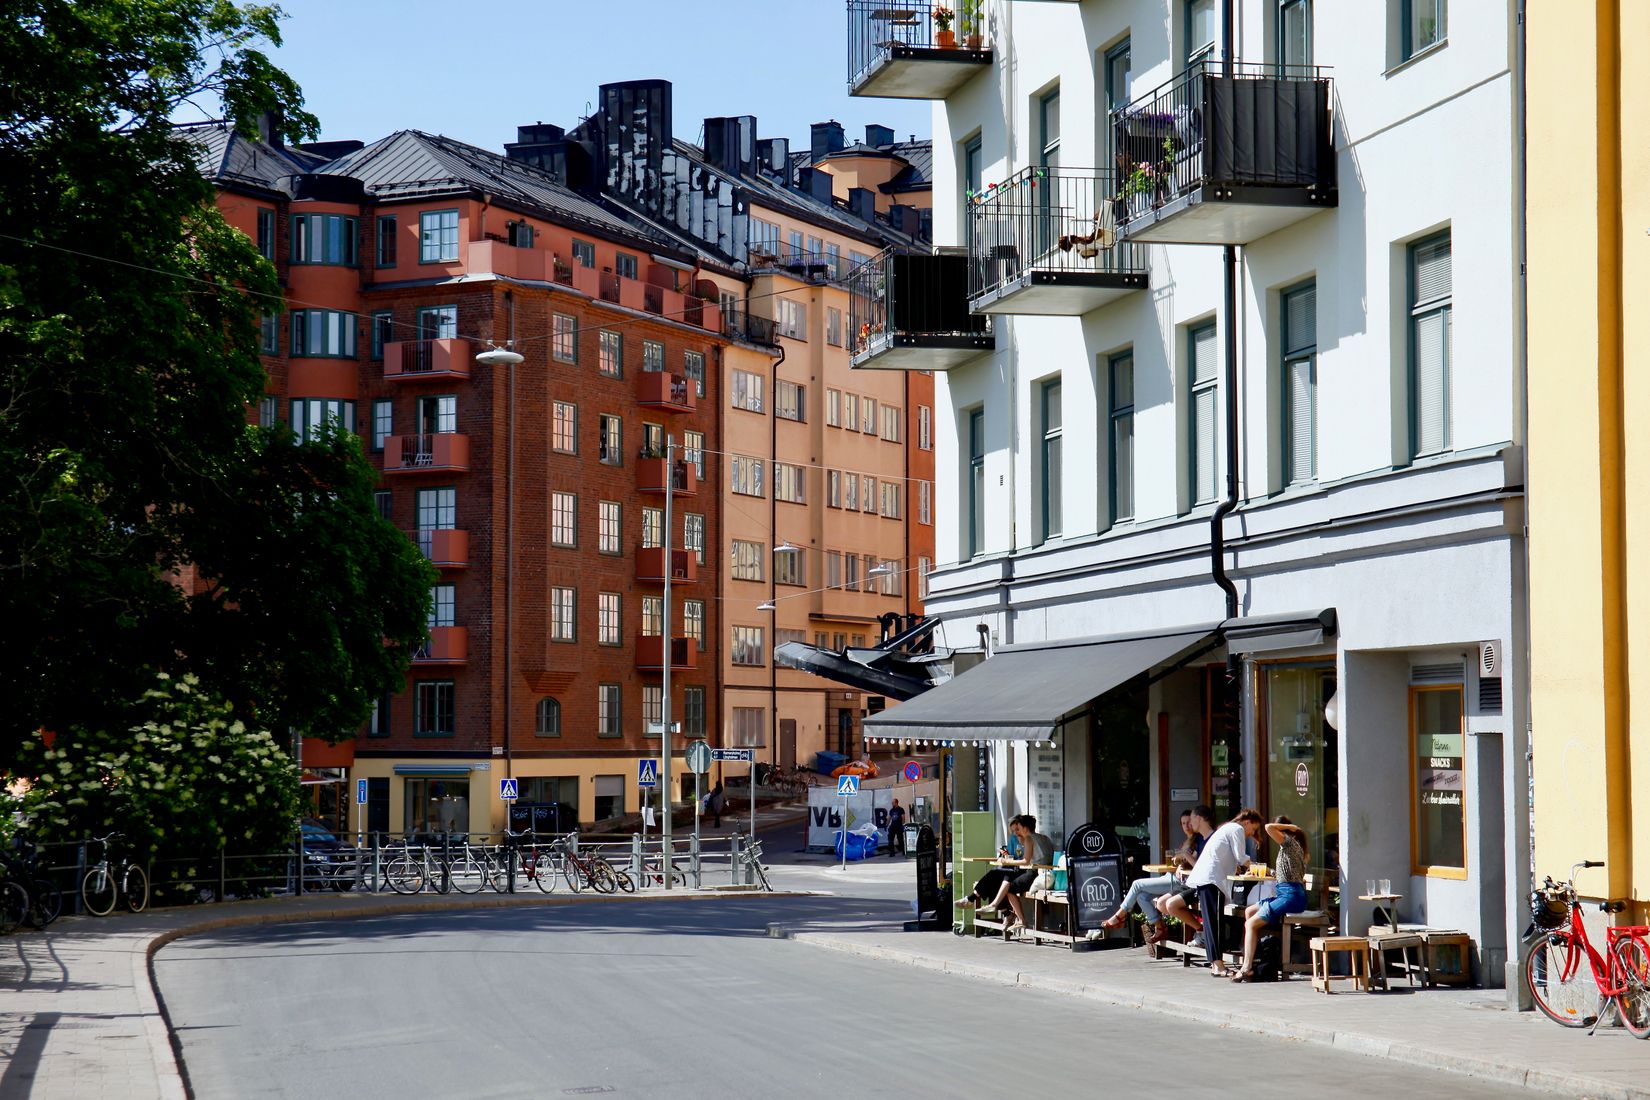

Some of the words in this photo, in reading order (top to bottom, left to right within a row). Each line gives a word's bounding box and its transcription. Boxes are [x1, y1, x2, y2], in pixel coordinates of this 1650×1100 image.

[1430, 757, 1450, 768] SNACKS
[1086, 836, 1100, 848] RIO
[1086, 884, 1109, 902] RIO
